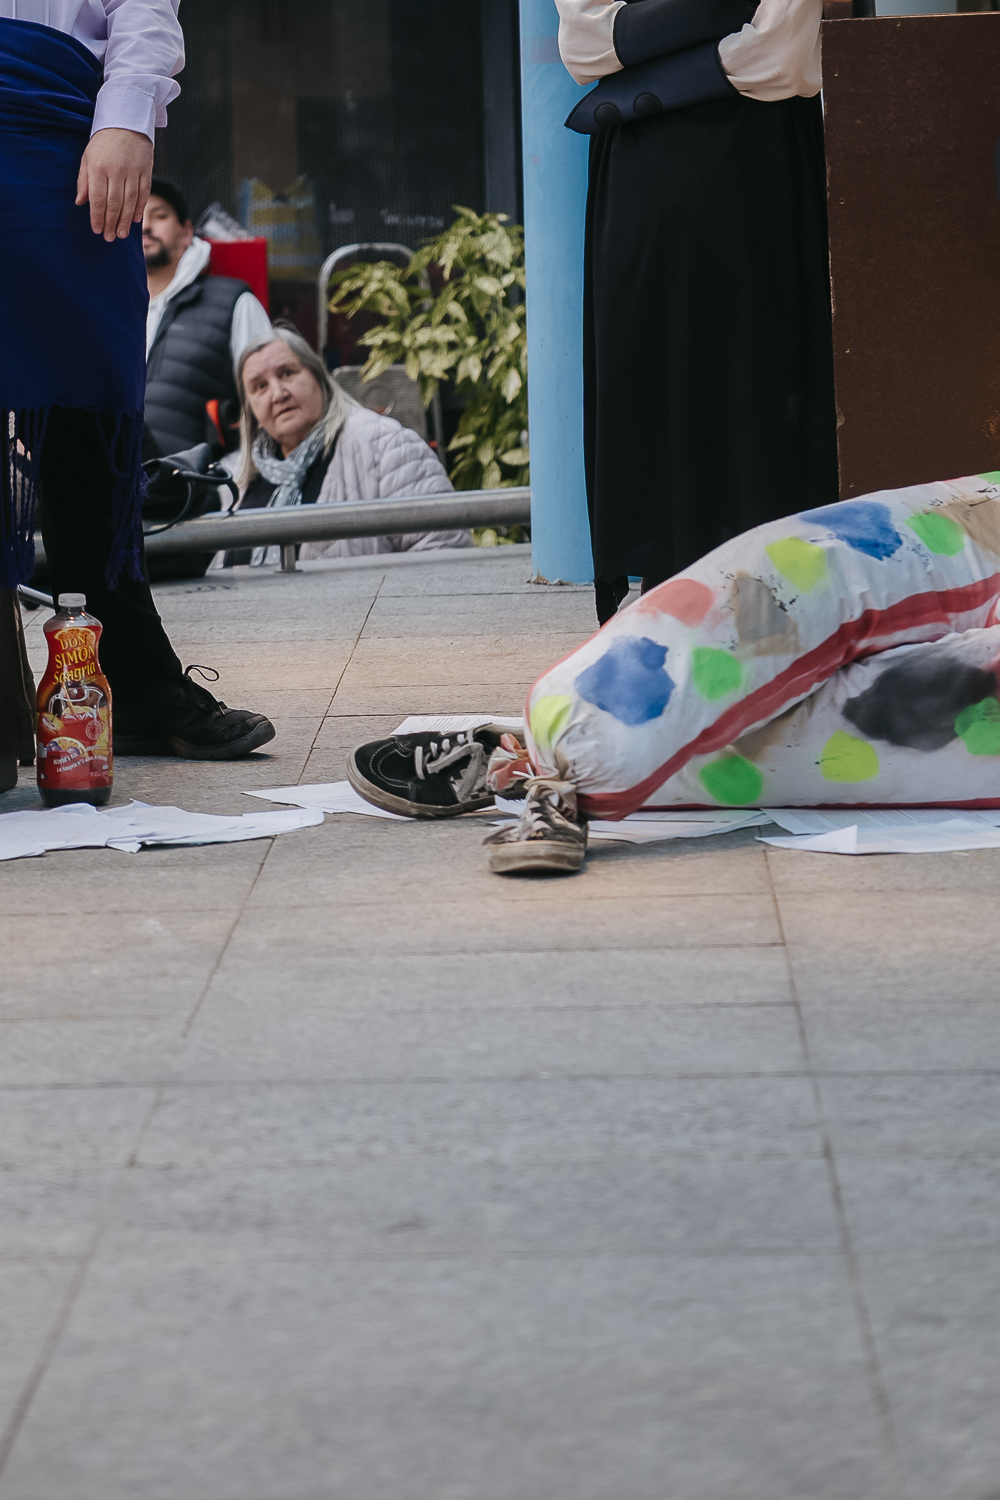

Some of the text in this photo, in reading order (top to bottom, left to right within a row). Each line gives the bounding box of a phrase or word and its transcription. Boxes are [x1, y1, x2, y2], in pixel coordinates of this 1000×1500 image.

[60, 634, 87, 651] DON
[54, 644, 96, 669] SIMON
[52, 661, 96, 685] Sangria
